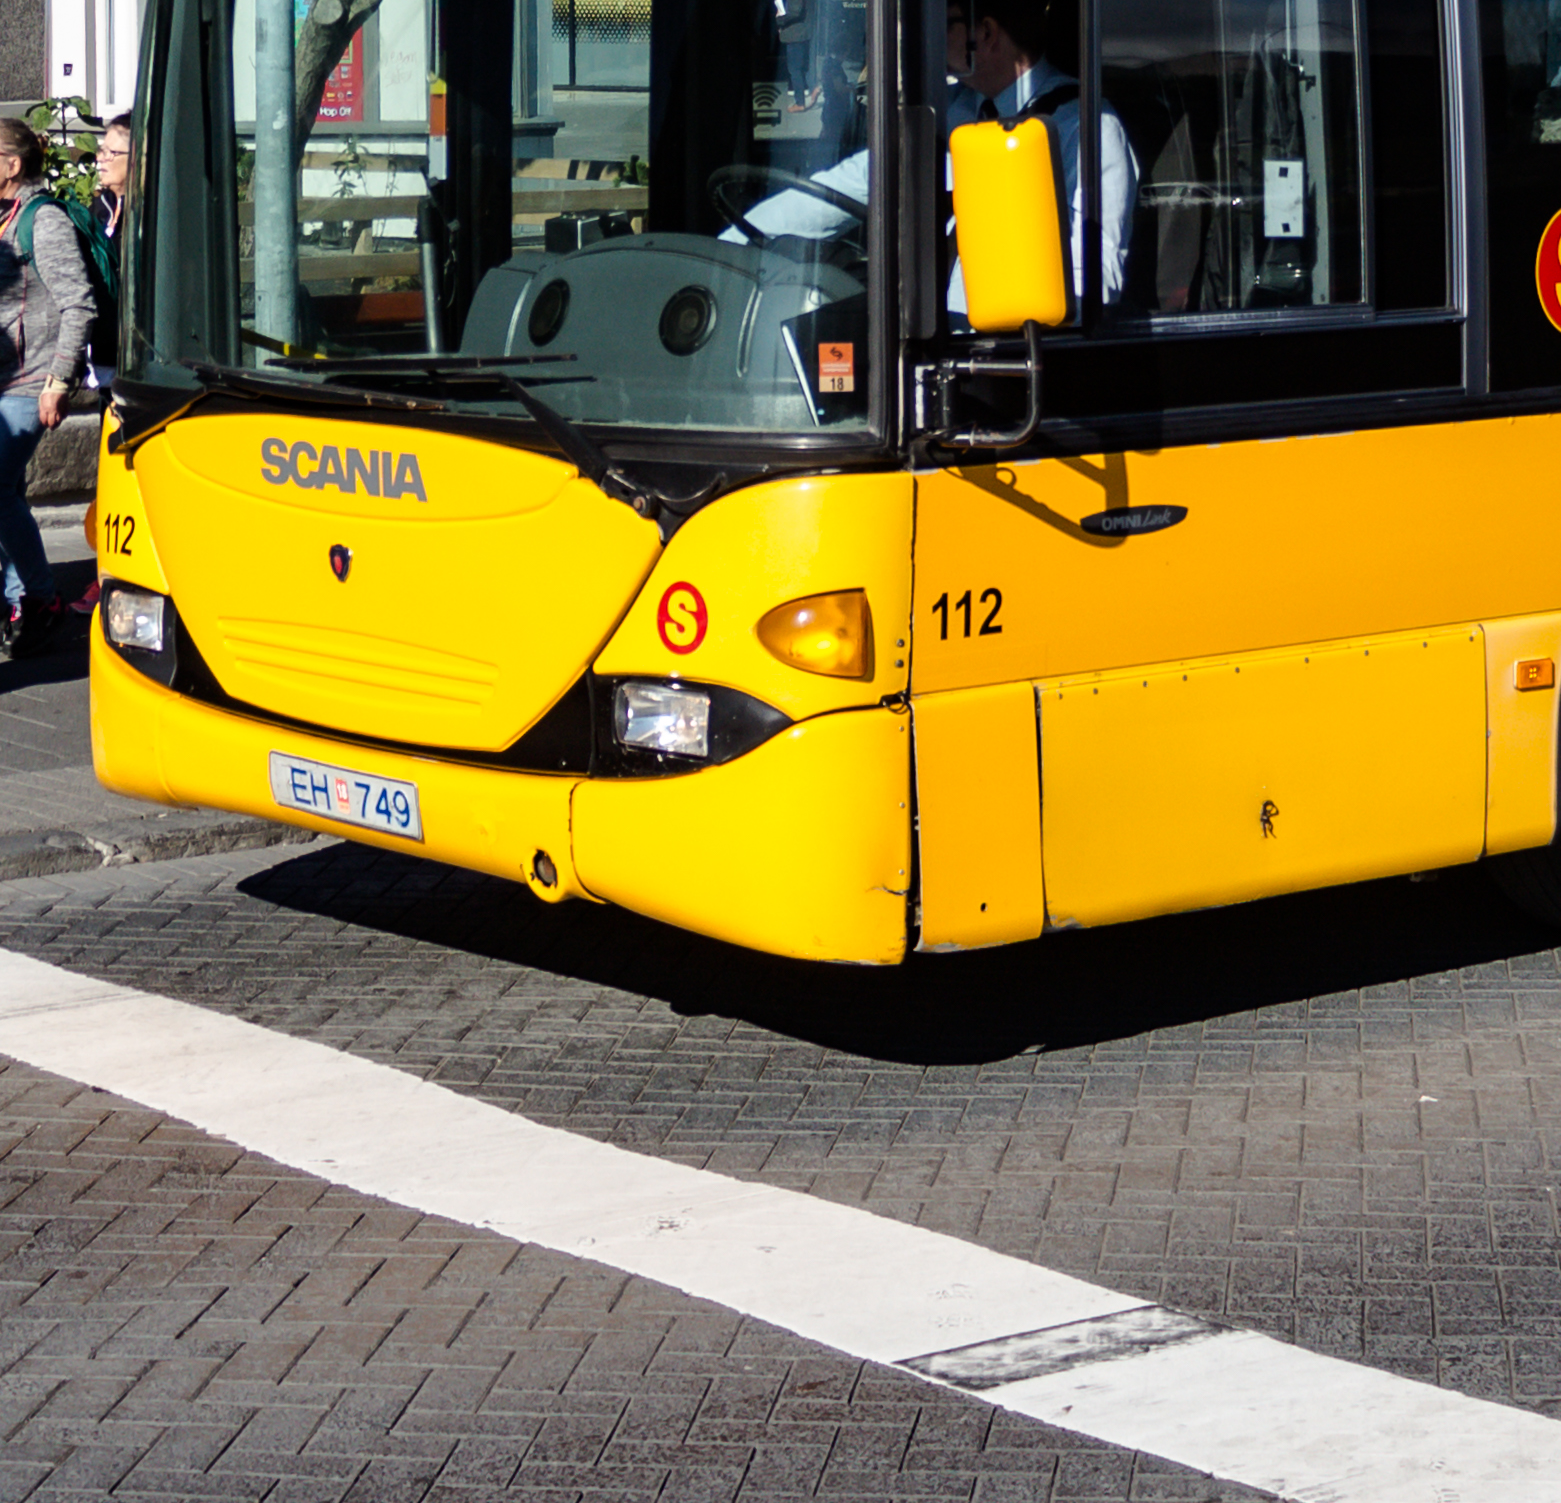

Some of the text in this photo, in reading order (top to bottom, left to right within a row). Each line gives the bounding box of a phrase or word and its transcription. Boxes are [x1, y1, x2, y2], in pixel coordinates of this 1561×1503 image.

[830, 377, 845, 391] 18
[260, 437, 429, 503] SCANIA
[104, 512, 136, 557] 112
[931, 587, 1003, 641] 112
[290, 766, 410, 829] EH 749
